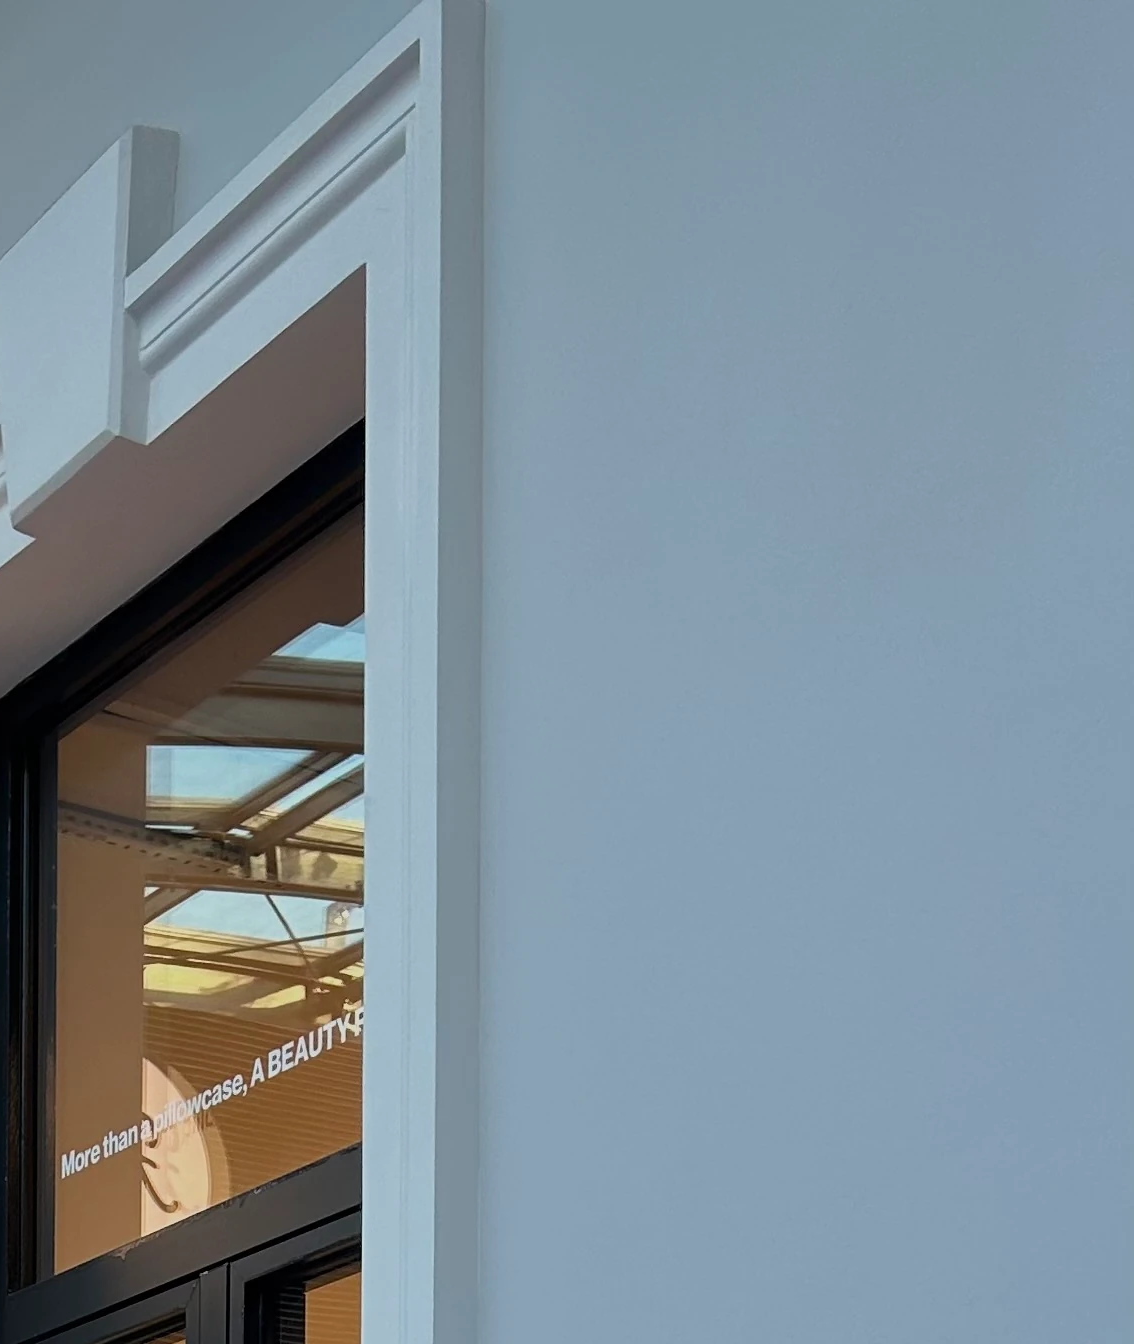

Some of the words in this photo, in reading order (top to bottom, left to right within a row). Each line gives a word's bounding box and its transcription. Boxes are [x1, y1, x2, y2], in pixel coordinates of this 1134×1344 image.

[61, 1145, 101, 1180] More
[103, 1125, 138, 1158] than
[140, 1119, 152, 1141] a
[153, 1073, 248, 1139] pillowcase,
[249, 1057, 265, 1088] A
